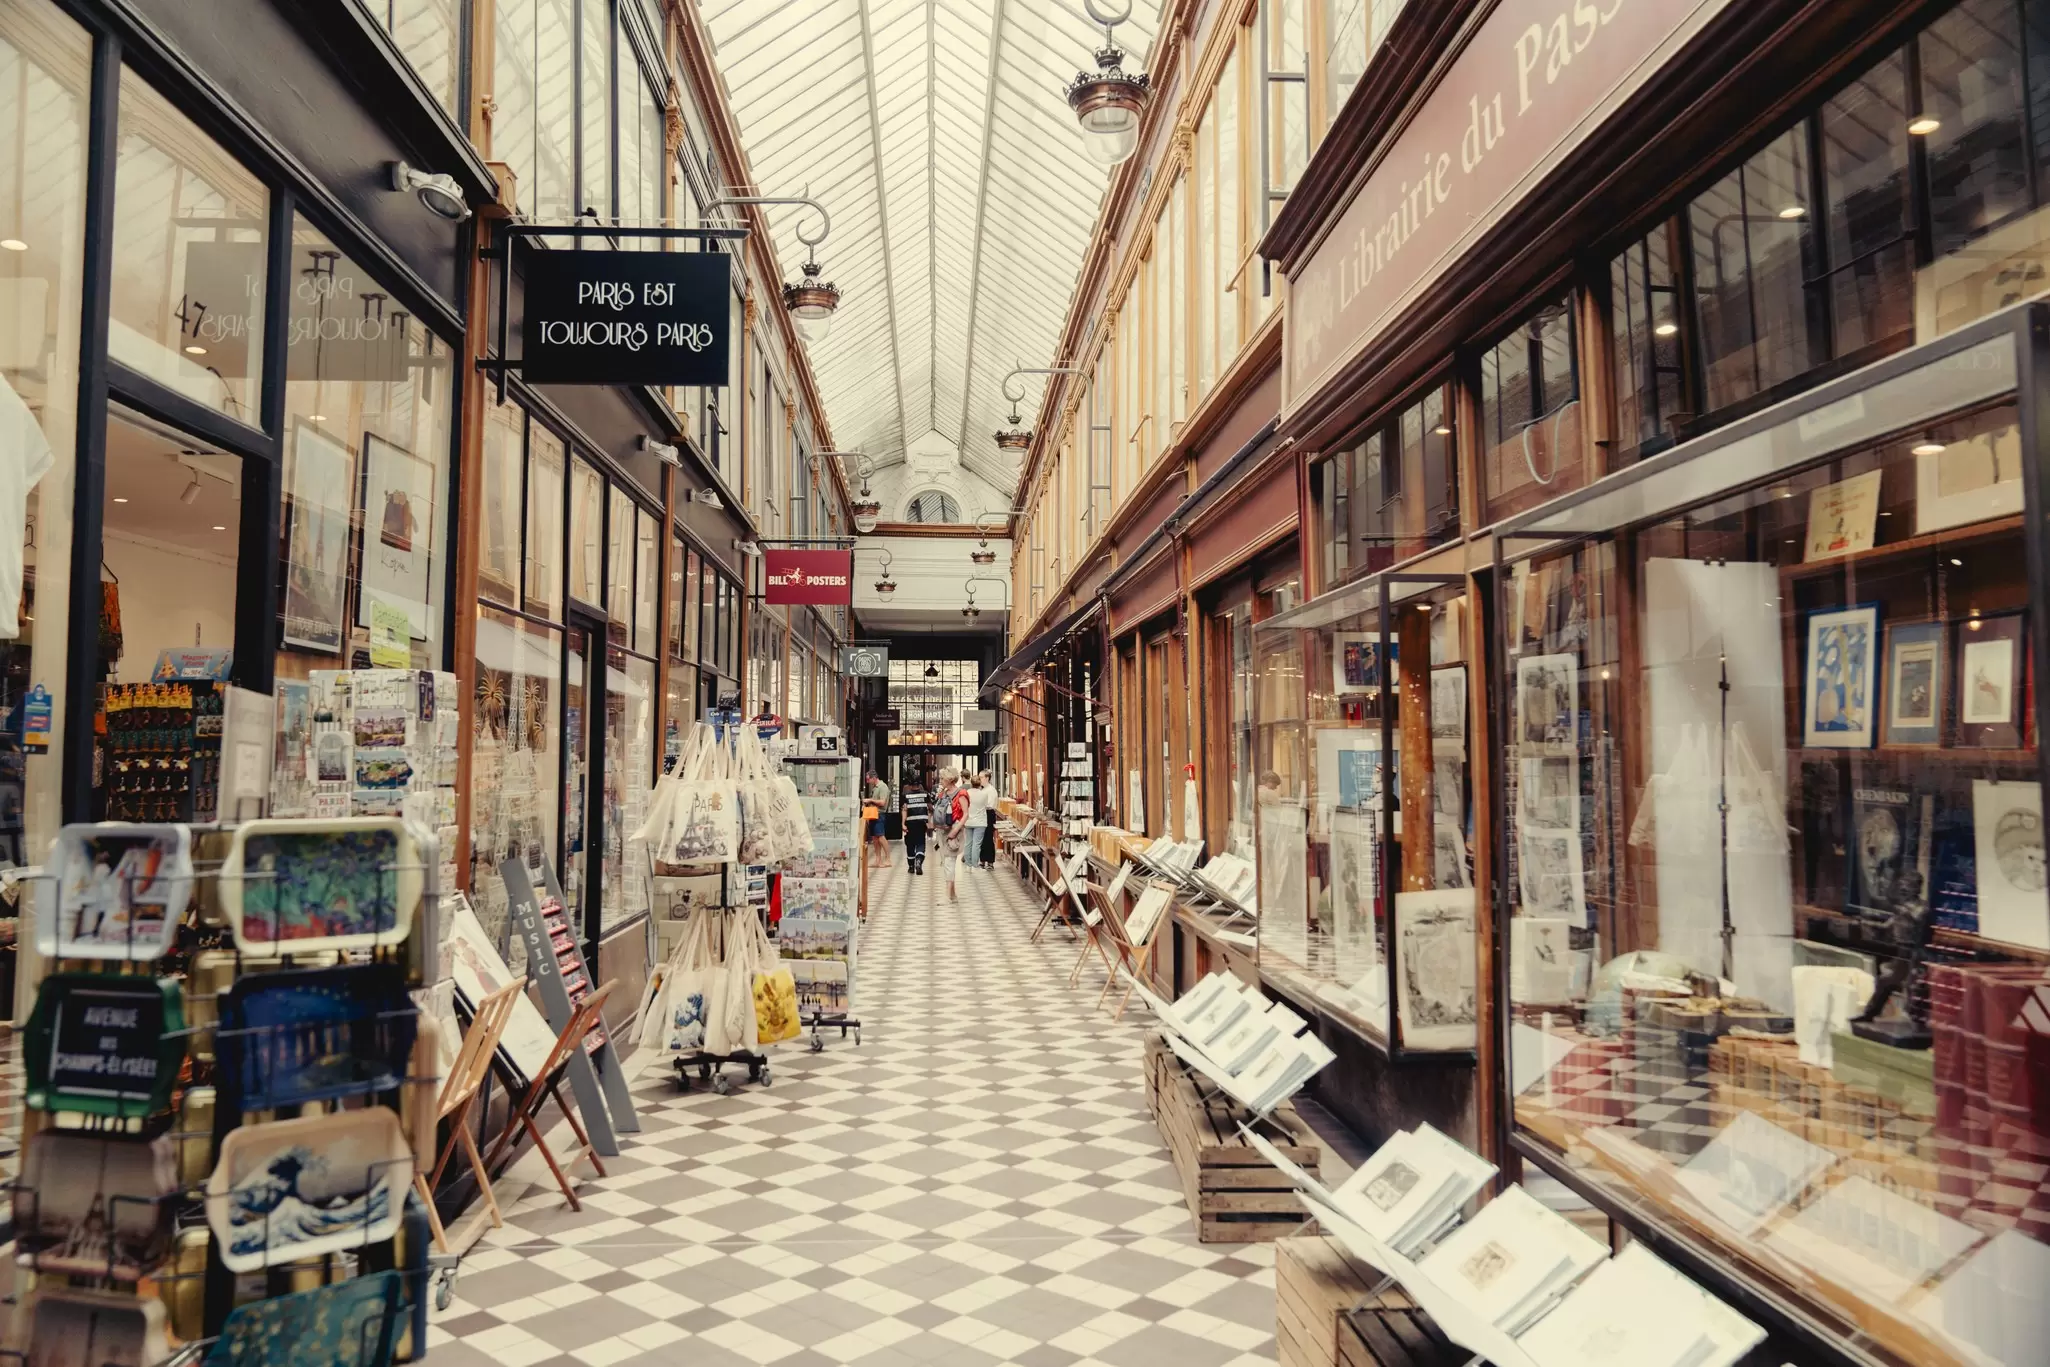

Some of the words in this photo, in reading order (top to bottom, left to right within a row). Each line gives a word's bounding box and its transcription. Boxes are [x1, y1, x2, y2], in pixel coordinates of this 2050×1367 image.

[1339, 151, 1452, 313] Librairie
[1461, 91, 1505, 174] du
[578, 281, 635, 311] PARIS
[644, 282, 676, 306] EST
[174, 293, 208, 339] 47
[540, 321, 648, 351] TOUJOURS
[657, 322, 713, 352] PARIS
[768, 576, 788, 586] BILL
[807, 576, 847, 586] POSTERS
[694, 796, 724, 813] PARS
[515, 901, 551, 976] MUSIC
